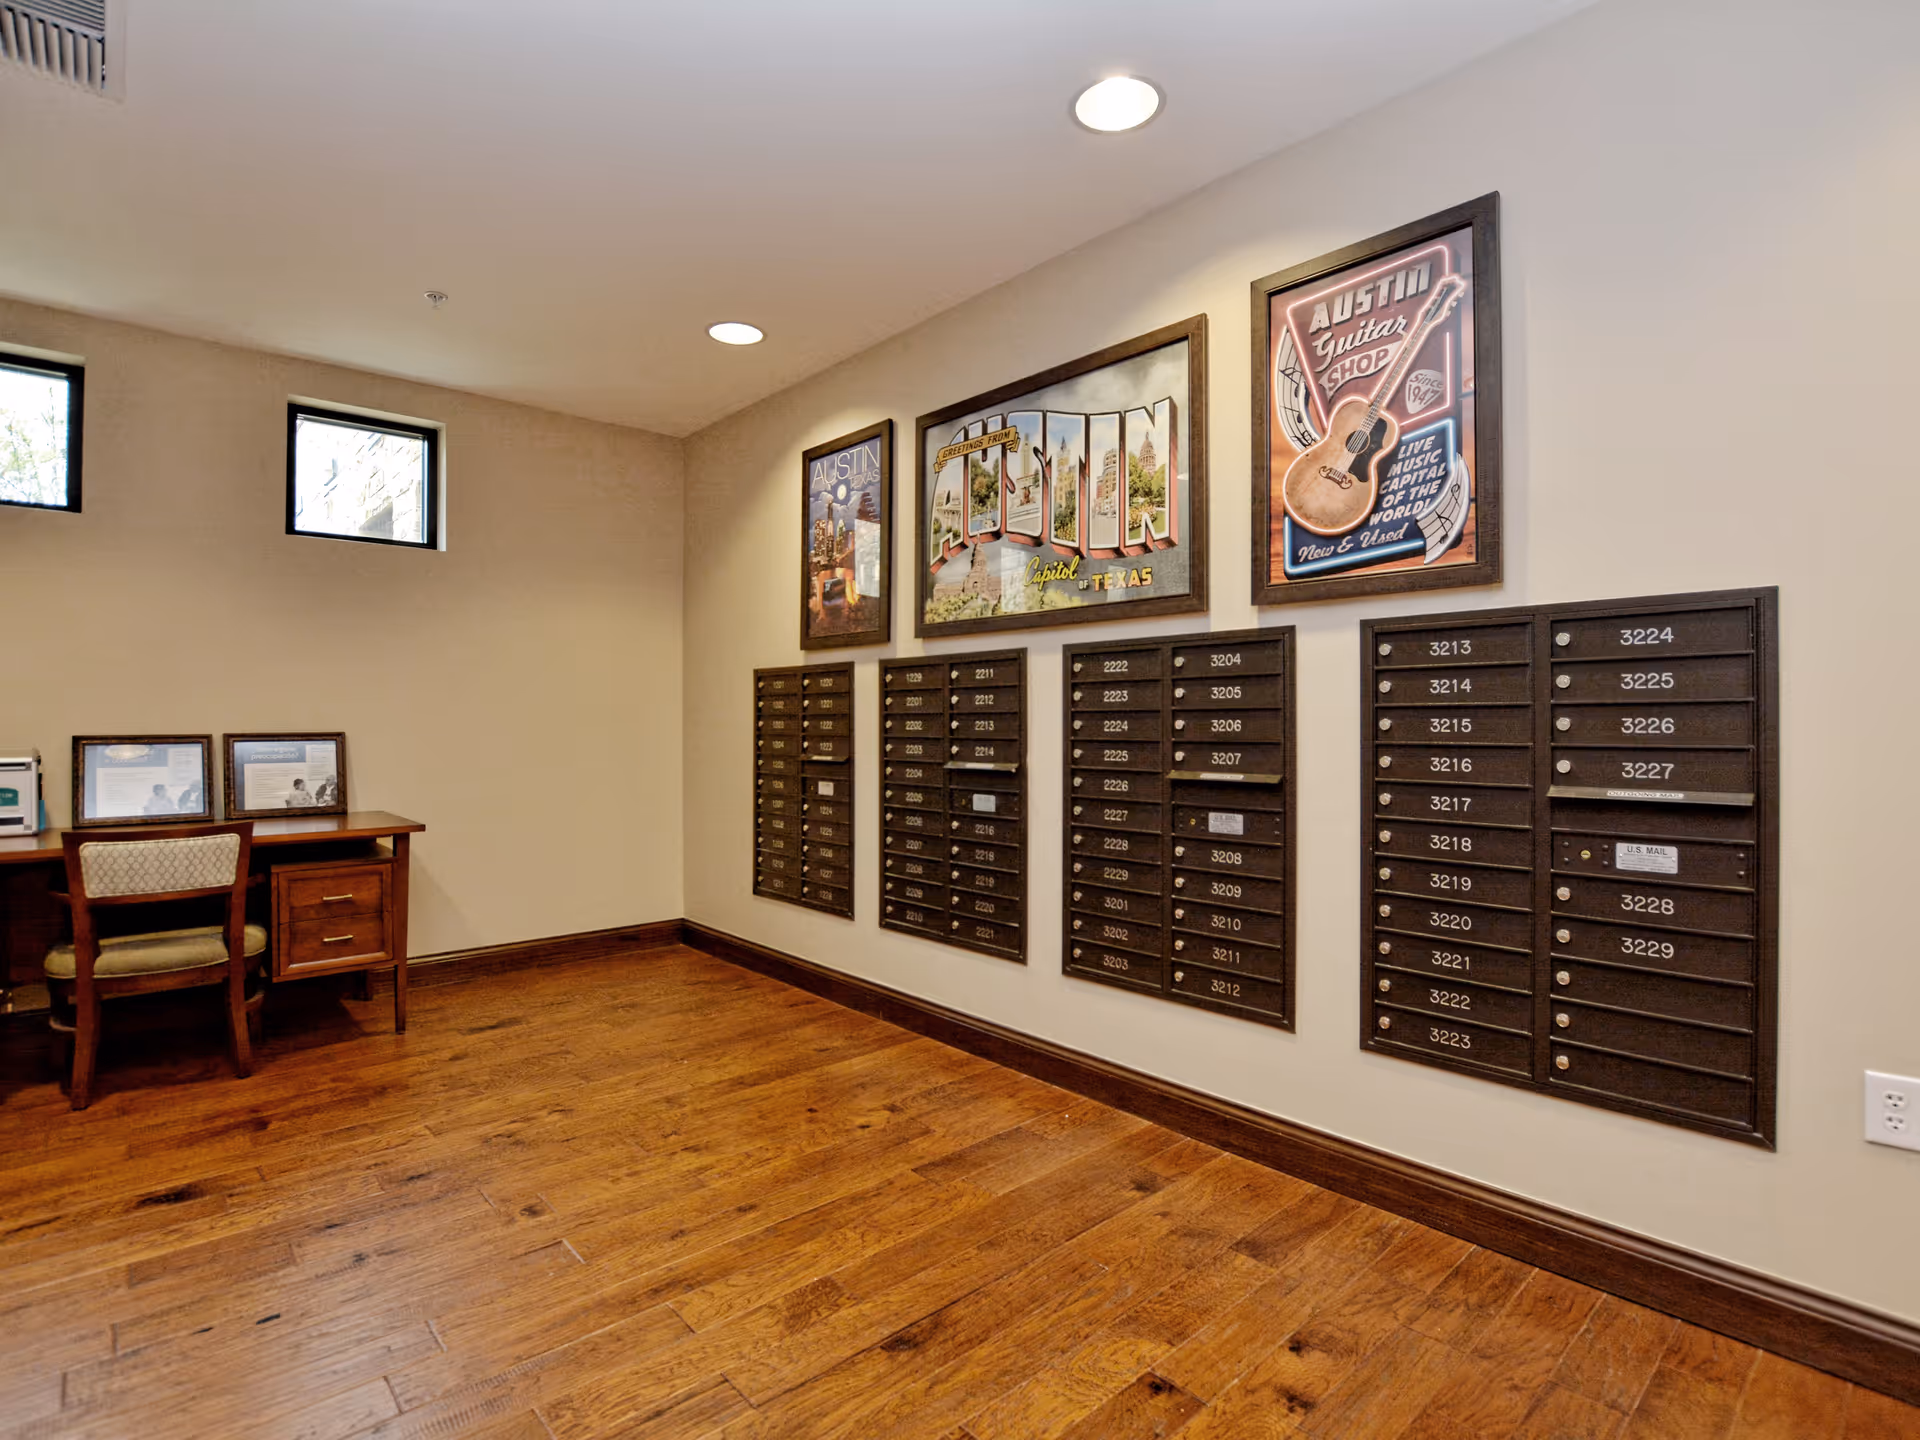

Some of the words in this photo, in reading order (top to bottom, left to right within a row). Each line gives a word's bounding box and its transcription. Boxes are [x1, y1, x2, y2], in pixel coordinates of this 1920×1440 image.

[1309, 262, 1432, 336] AUSTIN
[1312, 315, 1408, 373] Guitar
[1327, 348, 1389, 391] SHOP
[1409, 373, 1443, 388] Since
[1408, 384, 1441, 405] 1947
[943, 438, 983, 459] GREETINGS
[987, 429, 1011, 445] FROM
[1398, 435, 1436, 460] LIVE
[811, 440, 880, 489] AUSTIN
[1387, 448, 1443, 478] MUSIC
[848, 468, 880, 489] TEXAS
[931, 396, 1177, 575] AUSTIN
[1379, 462, 1447, 494] CAPITAL
[1382, 490, 1406, 508] OF
[1409, 479, 1442, 501] THE
[1369, 498, 1432, 526] WORLD!
[1298, 544, 1334, 562] New
[1337, 536, 1354, 553] &
[1360, 522, 1409, 548] Used
[1024, 555, 1080, 592] Capitol
[1092, 566, 1152, 592] TEXAS
[1620, 626, 1675, 646] 3224
[1429, 639, 1472, 656] 3213
[1103, 660, 1129, 673] 2222
[1210, 653, 1242, 667] 3204
[975, 668, 994, 680] 2211
[1620, 672, 1675, 690] 3225
[1210, 686, 1242, 699] 3205
[1429, 678, 1472, 694] 3214
[906, 696, 923, 707] 2201
[974, 694, 994, 706] 2212
[1103, 690, 1129, 703] 2223
[905, 720, 923, 731] 2202
[974, 720, 995, 731] 2213
[1103, 720, 1129, 732] 2224
[1210, 719, 1242, 732] 3206
[1430, 718, 1472, 733] 3215
[1621, 717, 1675, 734] 3226
[905, 744, 923, 755] 2203
[974, 746, 995, 757] 2214
[1103, 749, 1129, 762] 2225
[1211, 752, 1242, 765] 3207
[1430, 757, 1472, 773] 3216
[905, 768, 923, 778] 2204
[1621, 762, 1675, 780] 3227
[1103, 779, 1129, 792] 2226
[1430, 795, 1472, 812] 3217
[1103, 808, 1129, 822] 2227
[1103, 837, 1129, 851] 2228
[1430, 834, 1472, 852] 3218
[1626, 845, 1645, 855] U.S.
[1646, 846, 1669, 857] MAIL
[1211, 849, 1242, 865] 3208
[1103, 867, 1129, 881] 2229
[1430, 873, 1472, 891] 3219
[1211, 882, 1242, 898] 3209
[1104, 896, 1128, 911] 3201
[1620, 894, 1675, 915] 3228
[1211, 914, 1242, 931] 3210
[1429, 911, 1472, 931] 3220
[975, 926, 994, 939] 2221
[1103, 925, 1129, 941] 3202
[1211, 947, 1241, 964] 3211
[1621, 937, 1675, 959] 3229
[1102, 954, 1129, 971] 3203
[1430, 950, 1471, 971] 3221
[1210, 979, 1241, 998] 3212
[1429, 988, 1472, 1011] 3222
[1428, 1026, 1472, 1050] 3223
